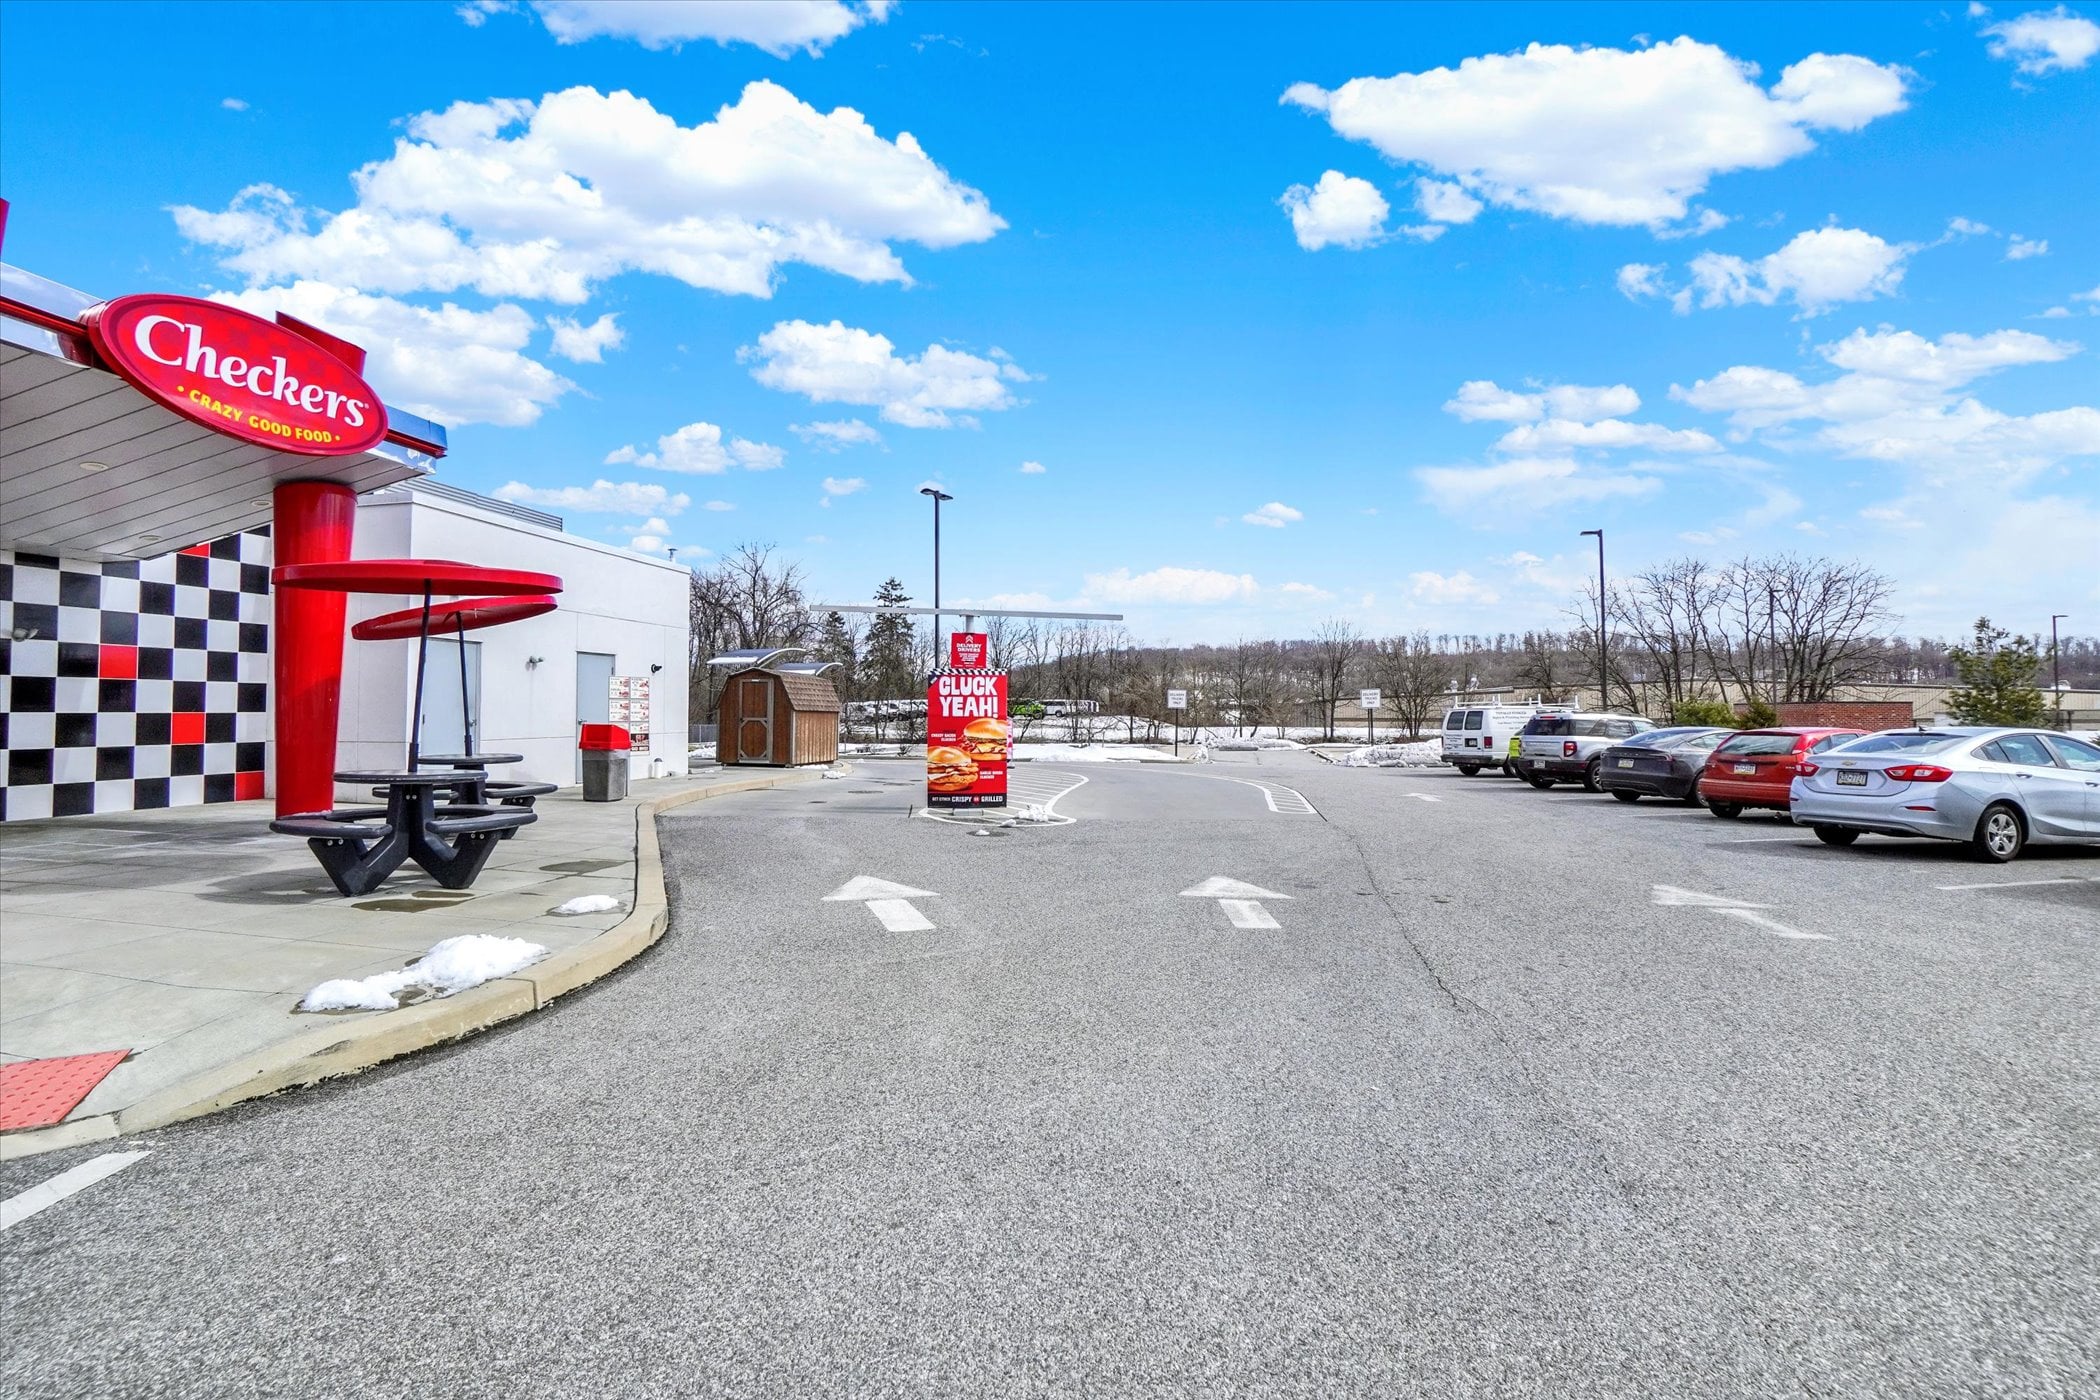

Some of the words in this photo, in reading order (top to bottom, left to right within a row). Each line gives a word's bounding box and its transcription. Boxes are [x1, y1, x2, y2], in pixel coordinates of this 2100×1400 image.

[134, 314, 365, 427] Checkers
[189, 389, 243, 422] CRAZY
[249, 415, 292, 438] GOOD
[295, 427, 332, 443] FOOD
[939, 676, 998, 696] CLUCK
[939, 696, 999, 719] YEAH!
